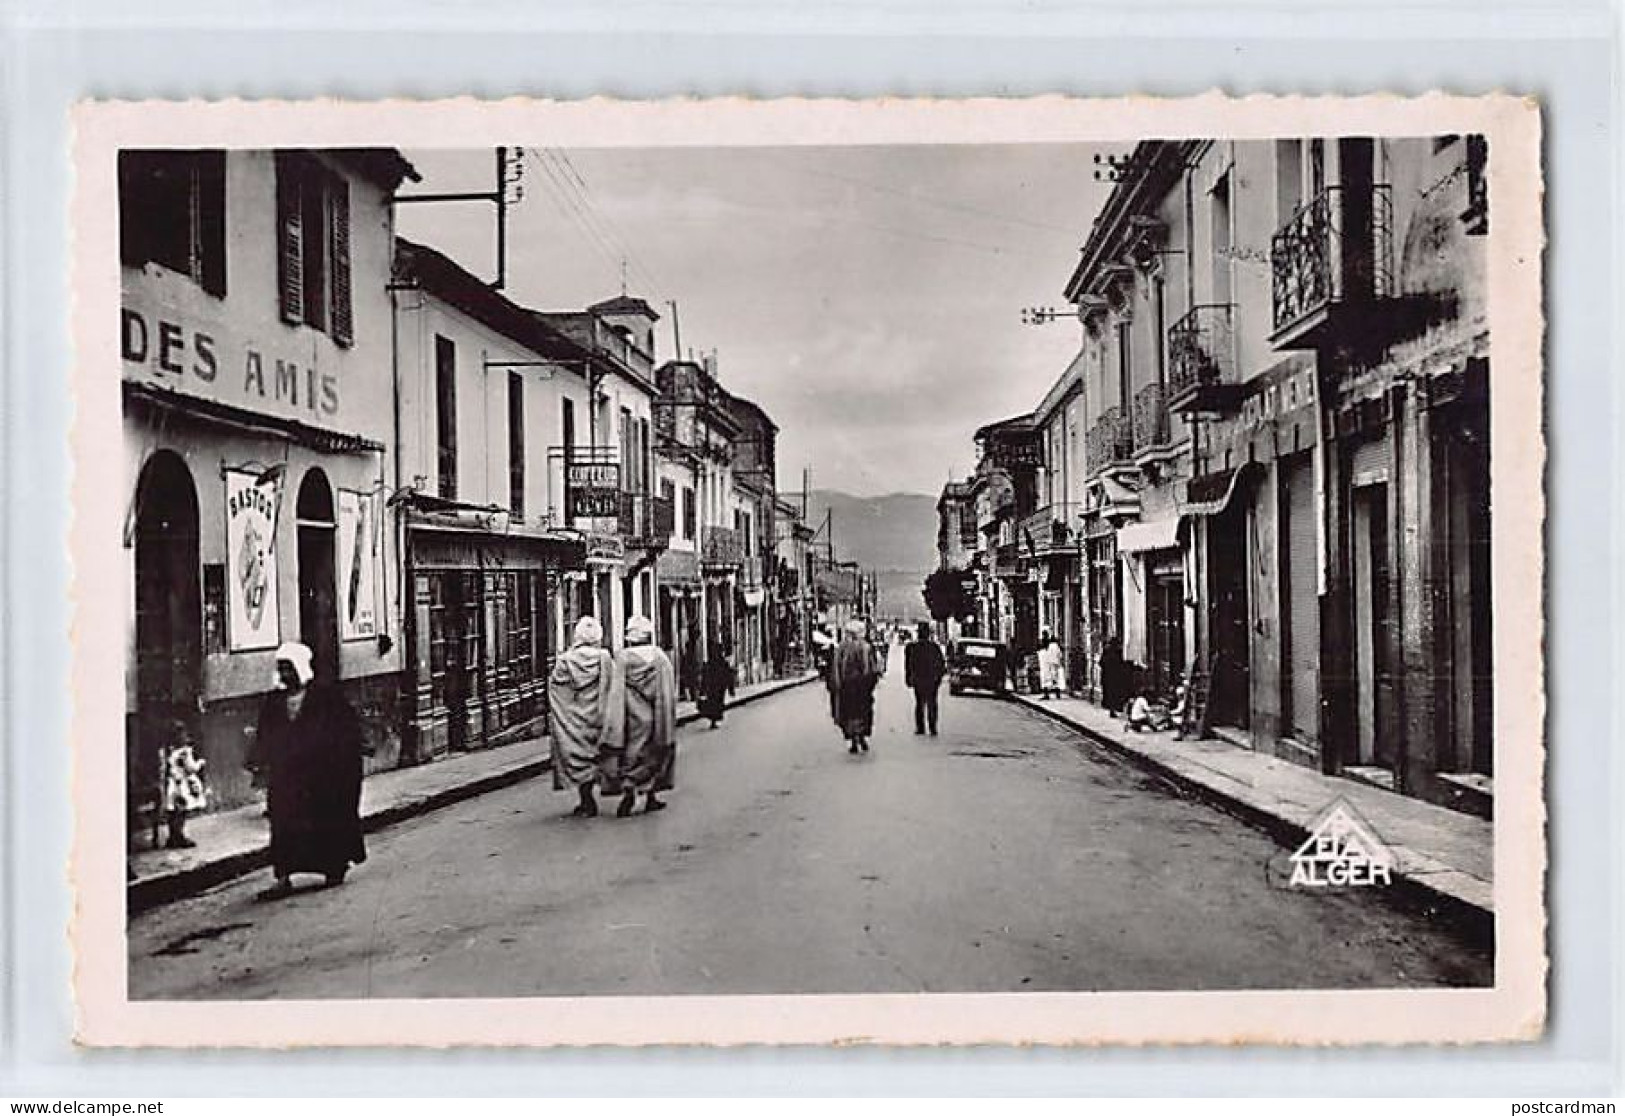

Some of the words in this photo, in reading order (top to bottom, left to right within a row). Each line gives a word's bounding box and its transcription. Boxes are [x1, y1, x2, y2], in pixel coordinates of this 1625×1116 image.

[121, 308, 217, 382] DES
[245, 350, 339, 414] AMIS
[229, 487, 272, 520] BASTOS
